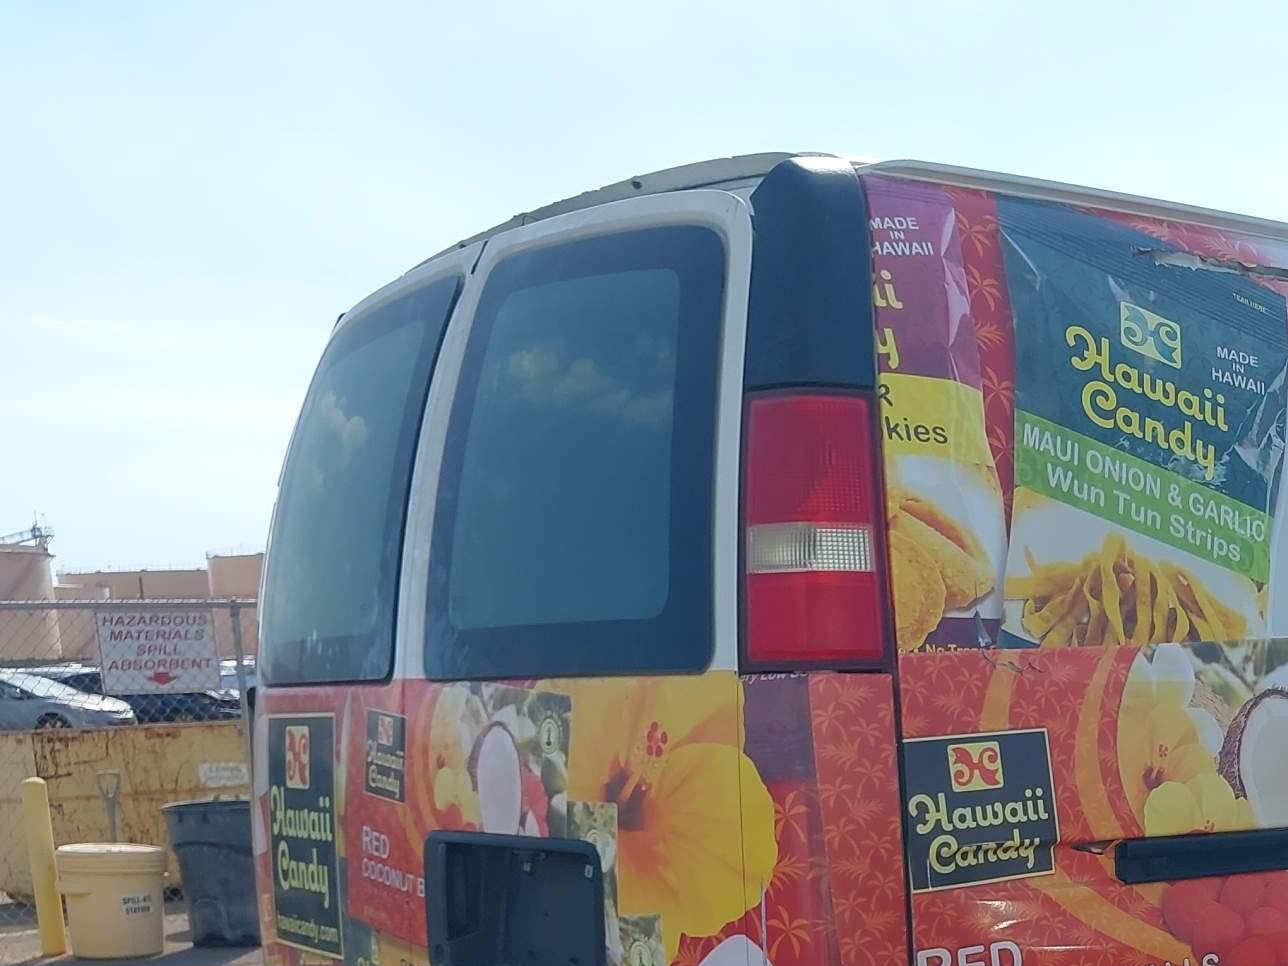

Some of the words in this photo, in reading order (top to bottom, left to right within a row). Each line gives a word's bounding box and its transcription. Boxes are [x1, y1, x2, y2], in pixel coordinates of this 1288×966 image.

[870, 216, 919, 229] MADE
[890, 230, 905, 240] IN
[1216, 346, 1259, 367] MADE
[1232, 363, 1244, 373] IN
[1065, 325, 1229, 432] Hawaii
[1212, 367, 1265, 395] HAWAII
[1082, 380, 1216, 481] Candy
[1023, 423, 1079, 465] MAUI
[1086, 451, 1161, 499] ONION
[1168, 484, 1183, 508] &
[1047, 463, 1105, 507] Wun
[1113, 490, 1161, 530] Tun
[1169, 514, 1241, 562] Strips
[102, 614, 208, 628] HAZARDOUS
[109, 629, 205, 642] MATERIALS
[108, 658, 211, 671] ABSORBENT
[135, 643, 182, 656] SPILL
[368, 764, 400, 799] Candy
[271, 785, 332, 842] Hawaii
[908, 787, 1048, 835] Hawaii
[362, 825, 390, 859] RED
[929, 829, 1040, 874] Candy
[278, 840, 329, 909] Candy
[362, 856, 415, 894] COCONUT
